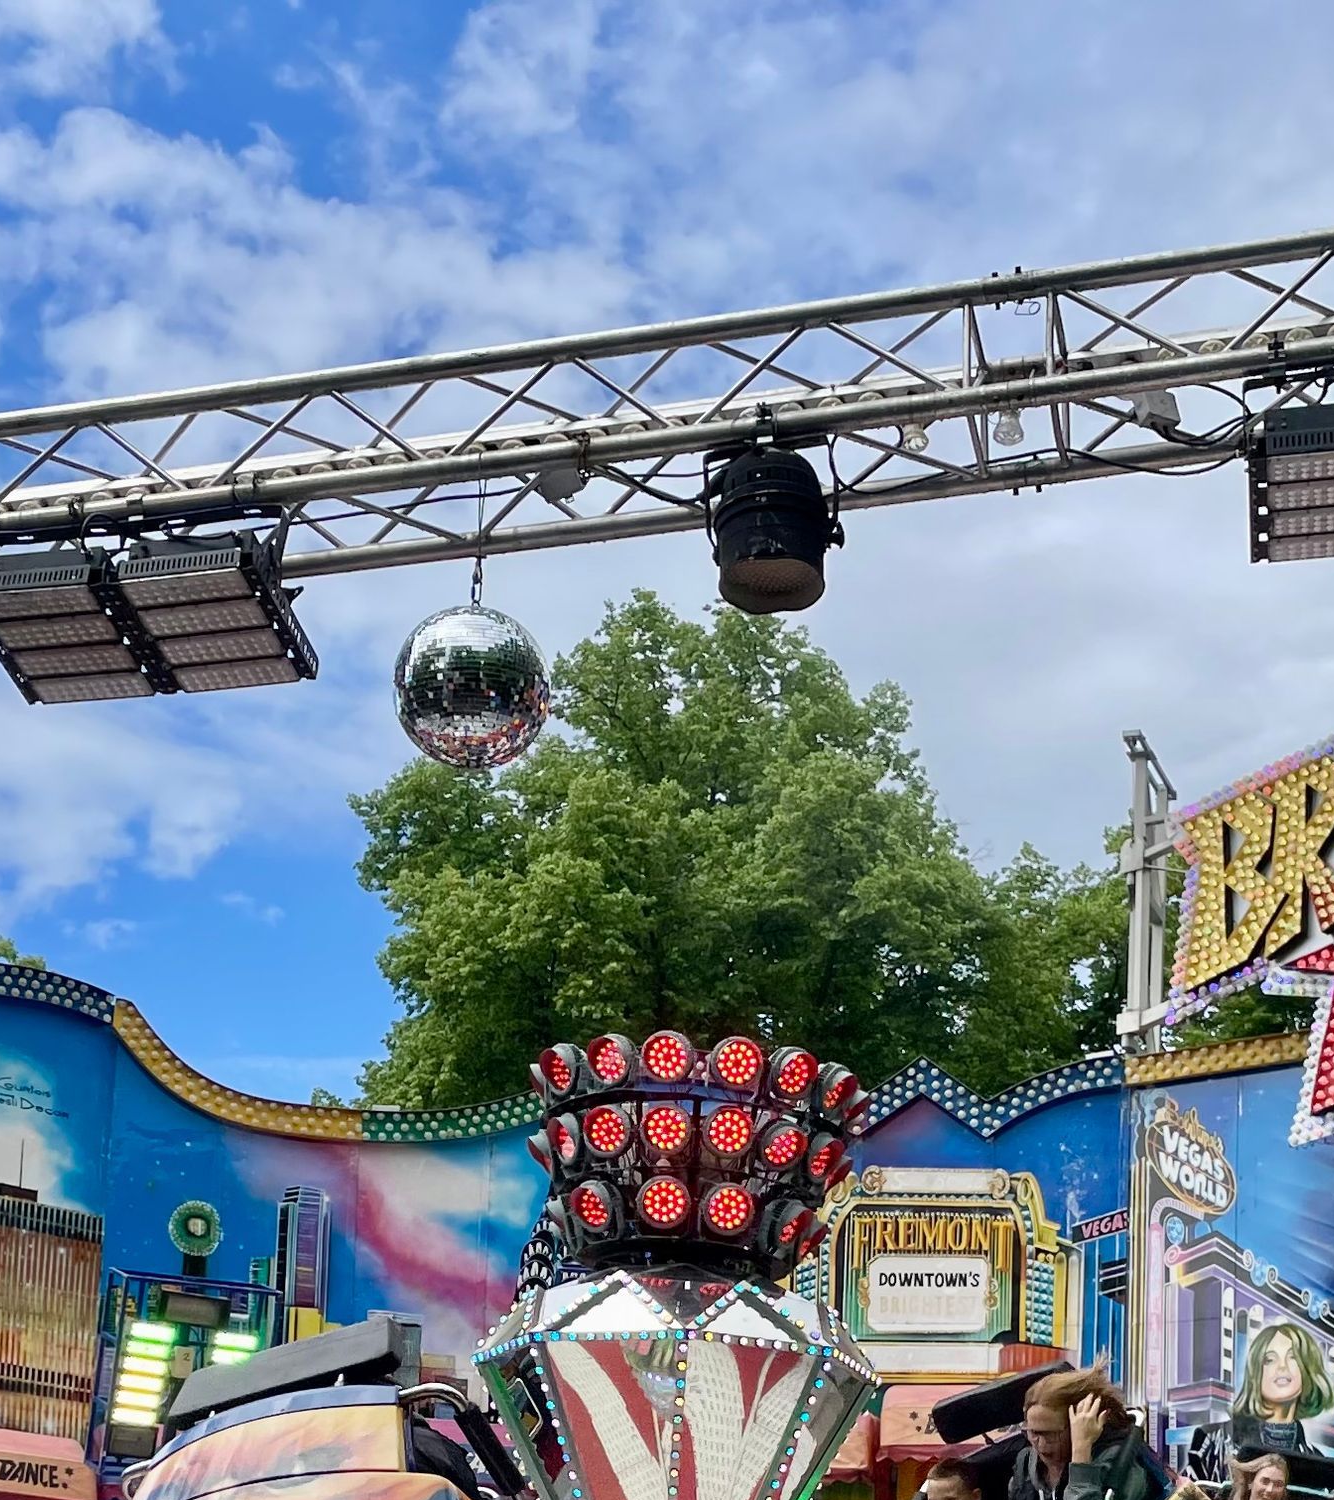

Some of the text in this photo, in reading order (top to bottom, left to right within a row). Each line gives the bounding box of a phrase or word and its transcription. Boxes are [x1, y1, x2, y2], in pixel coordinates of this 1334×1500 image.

[1158, 1150, 1228, 1207] WORLD
[1161, 1124, 1226, 1182] VEGAS
[851, 1216, 1015, 1272] FREMONT
[878, 1271, 981, 1288] DOWNTOWN'S
